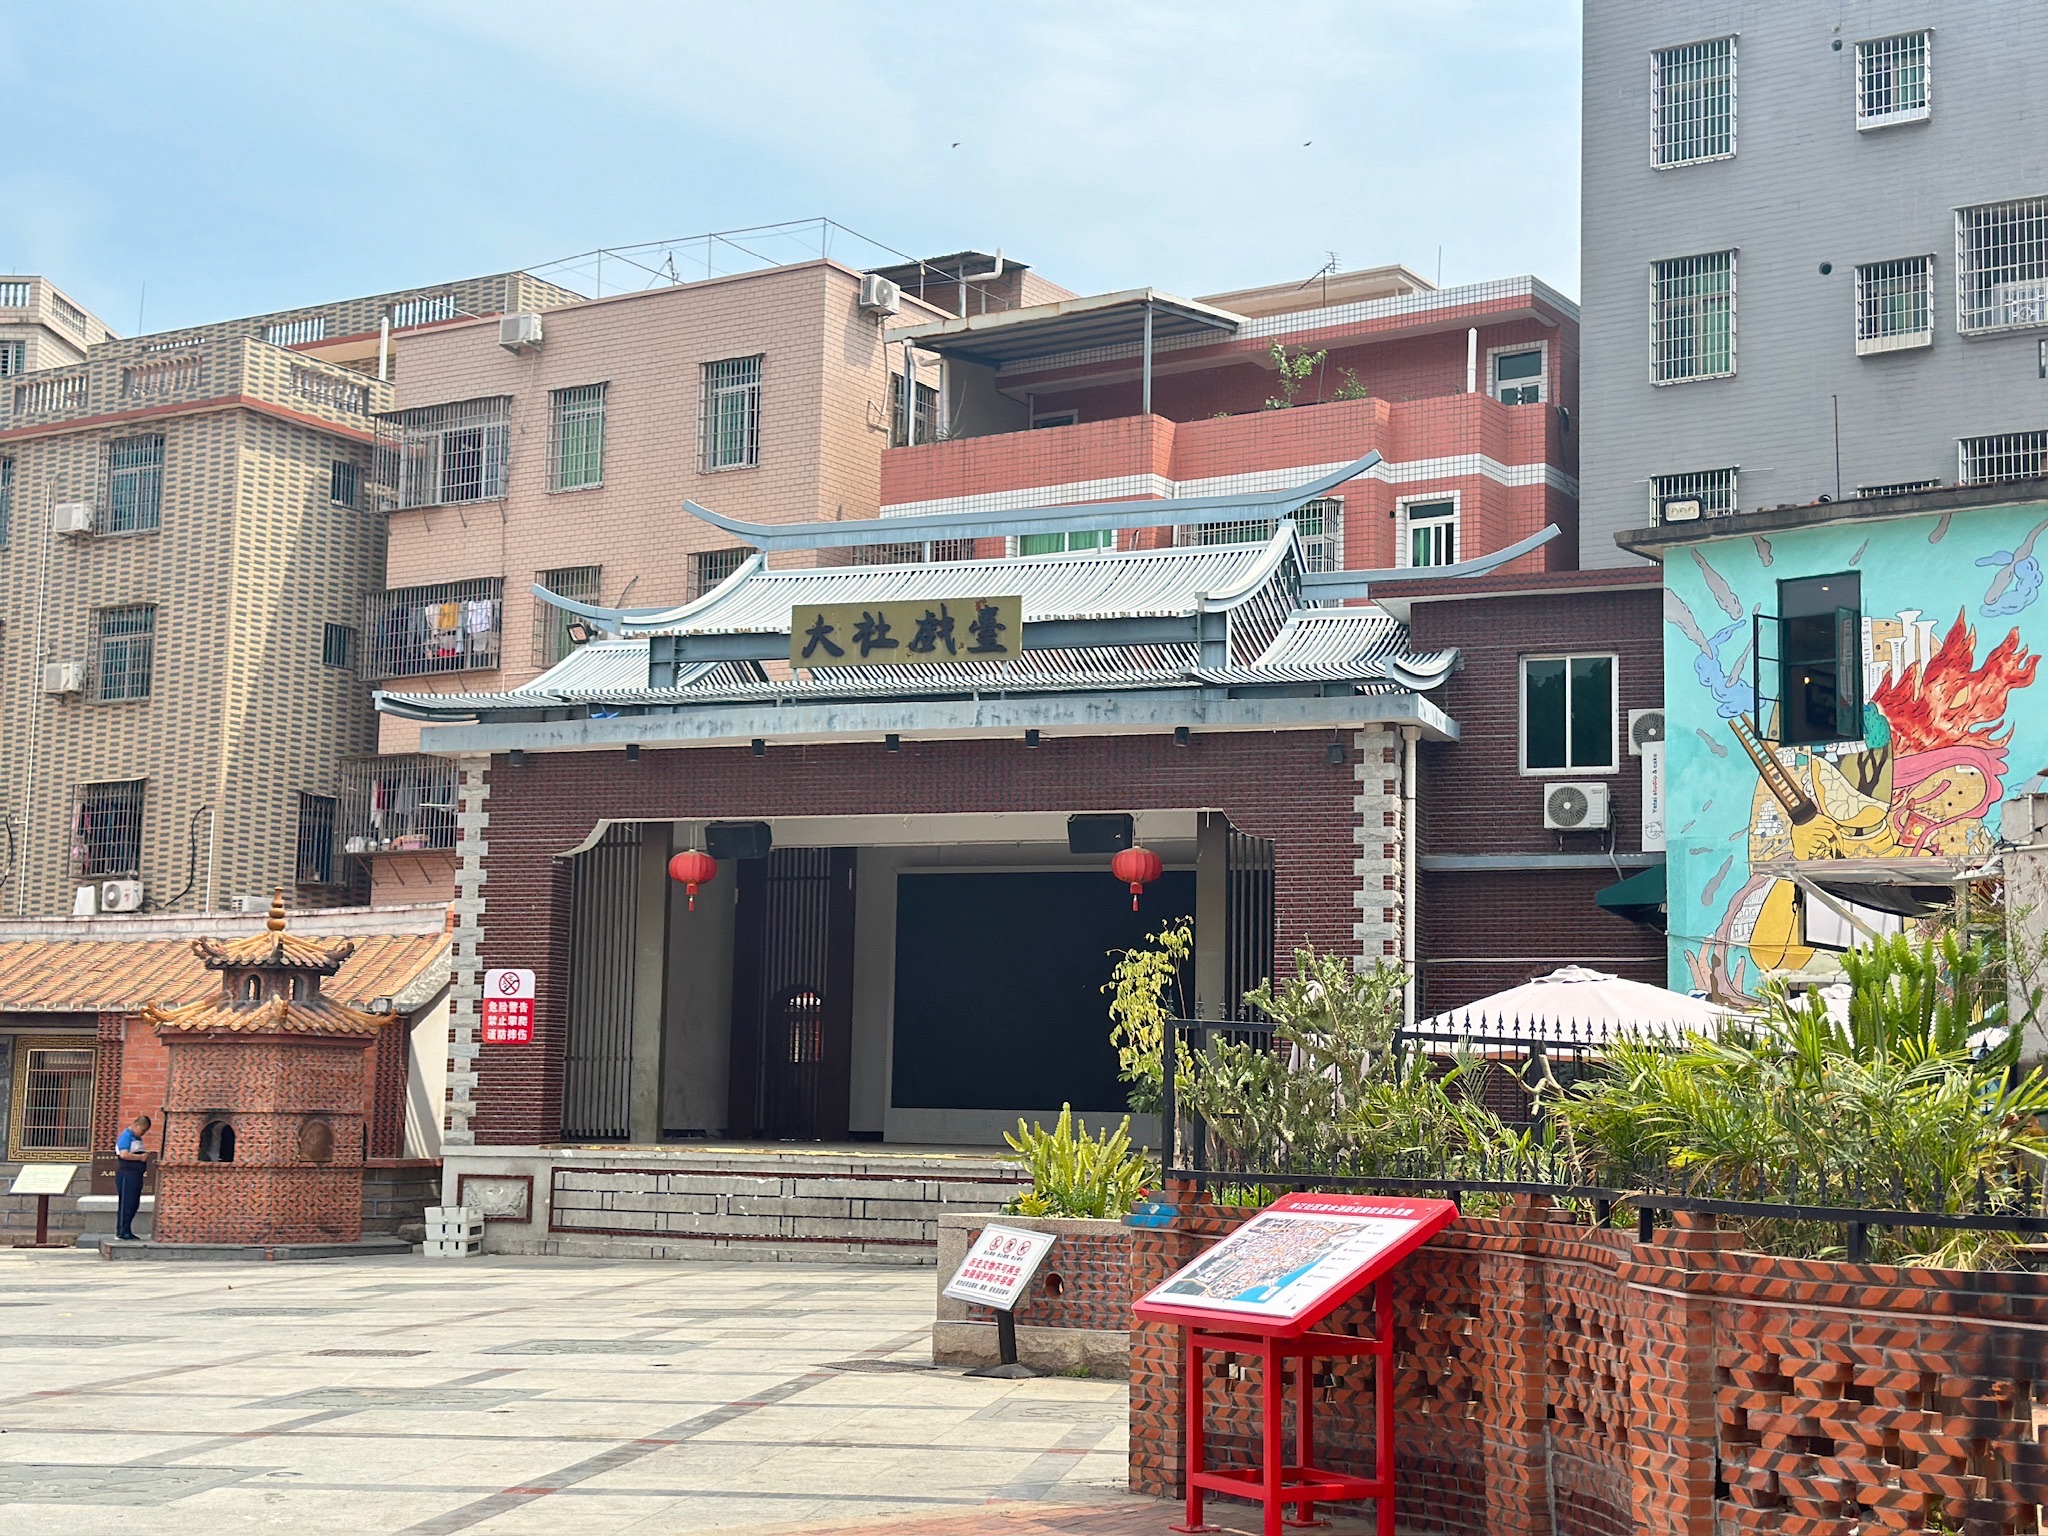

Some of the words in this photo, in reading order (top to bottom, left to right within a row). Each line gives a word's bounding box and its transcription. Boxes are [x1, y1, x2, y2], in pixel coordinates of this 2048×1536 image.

[488, 1001, 529, 1013] 危险警告
[487, 1015, 528, 1027] 禁止攀爬
[486, 1028, 528, 1040] 谨防摔伤
